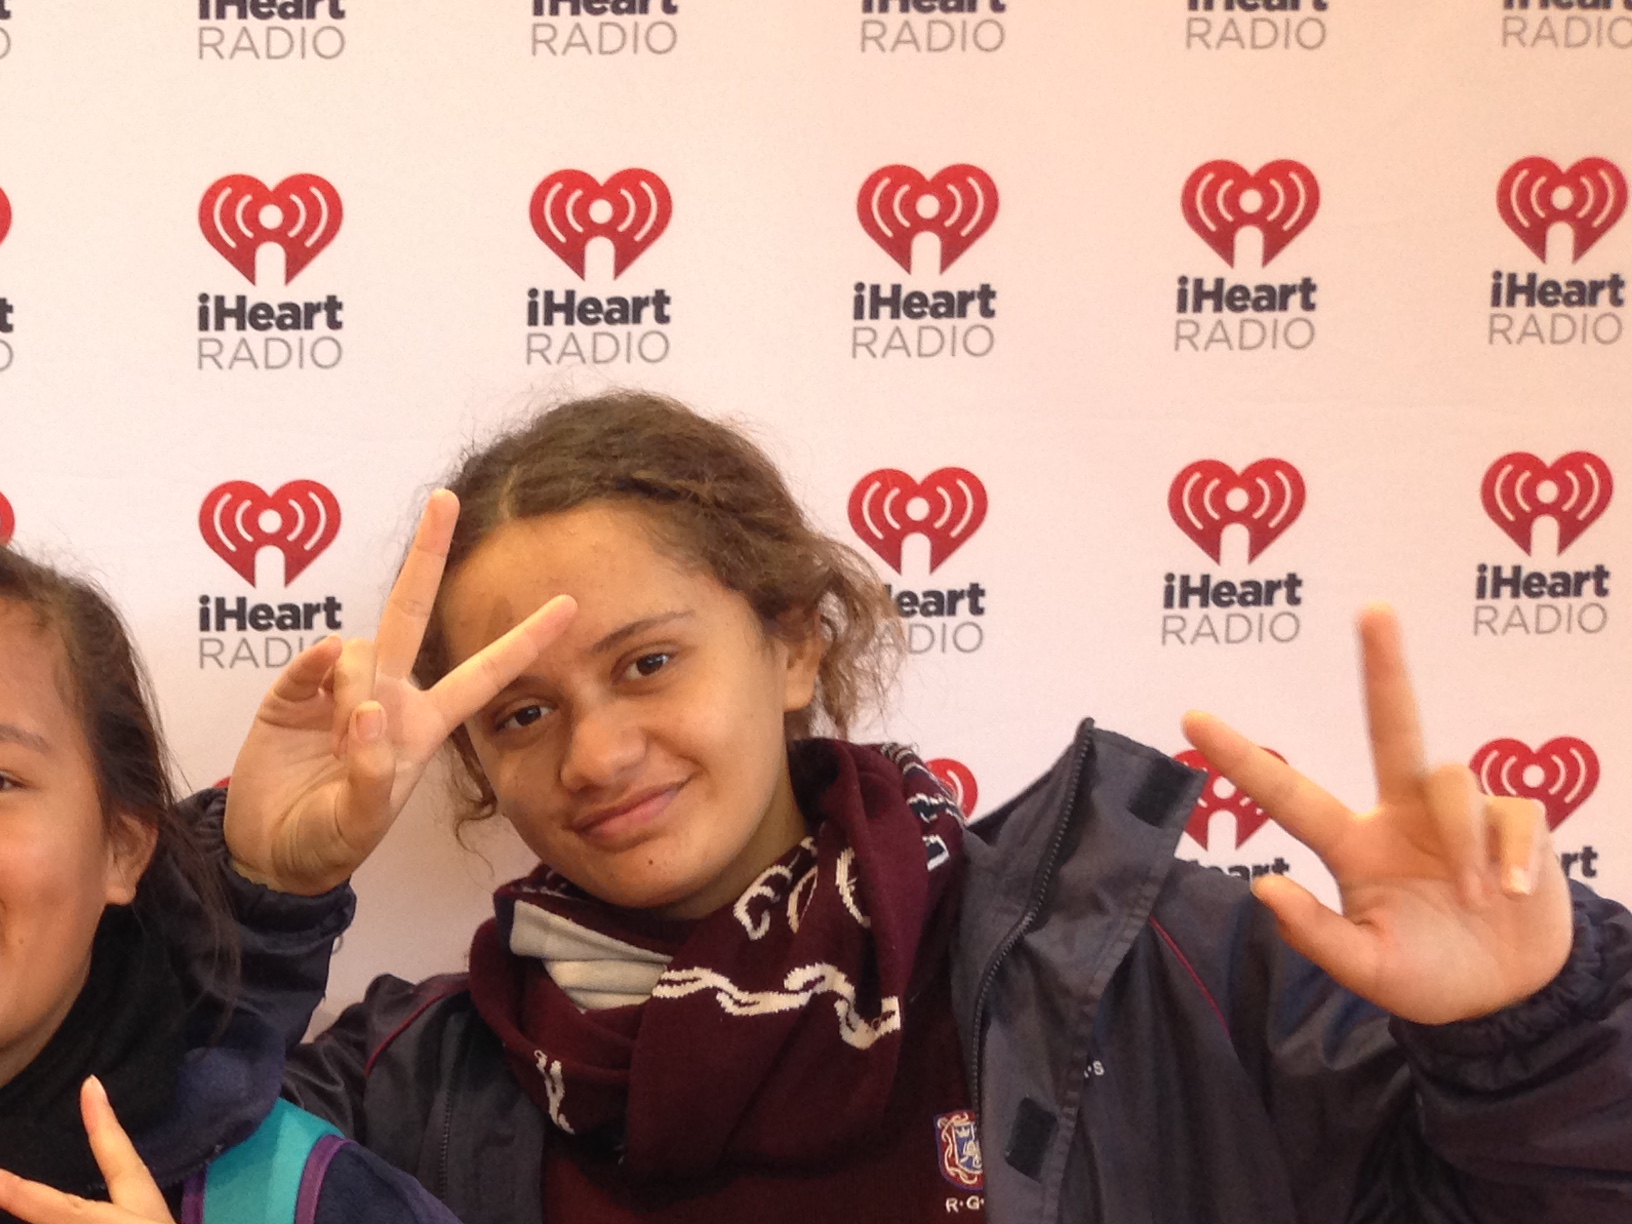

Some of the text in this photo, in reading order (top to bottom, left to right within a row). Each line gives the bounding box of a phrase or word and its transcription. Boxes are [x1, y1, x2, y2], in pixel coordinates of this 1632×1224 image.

[199, 26, 347, 61] RADIO
[532, 21, 678, 57] RADIO
[861, 20, 1006, 54] RADIO
[1187, 18, 1328, 51] RADIO
[1503, 16, 1632, 50] RADIO
[527, 288, 673, 328] iHeart
[853, 282, 999, 322] iHeart
[1177, 275, 1319, 316] iHeart
[1491, 270, 1628, 310] iHeart
[198, 293, 345, 333] iHeart
[1489, 313, 1623, 346] RADIO
[527, 331, 671, 368] RADIO
[853, 324, 996, 360] RADIO
[1175, 318, 1316, 352] RADIO
[198, 337, 344, 371] RADIO
[884, 582, 986, 618] eart
[1164, 573, 1305, 611] iHeart
[1476, 563, 1612, 602] iHeart
[199, 595, 345, 634] iHeart
[1163, 612, 1302, 647] RADIO
[1474, 603, 1609, 637] RADIO
